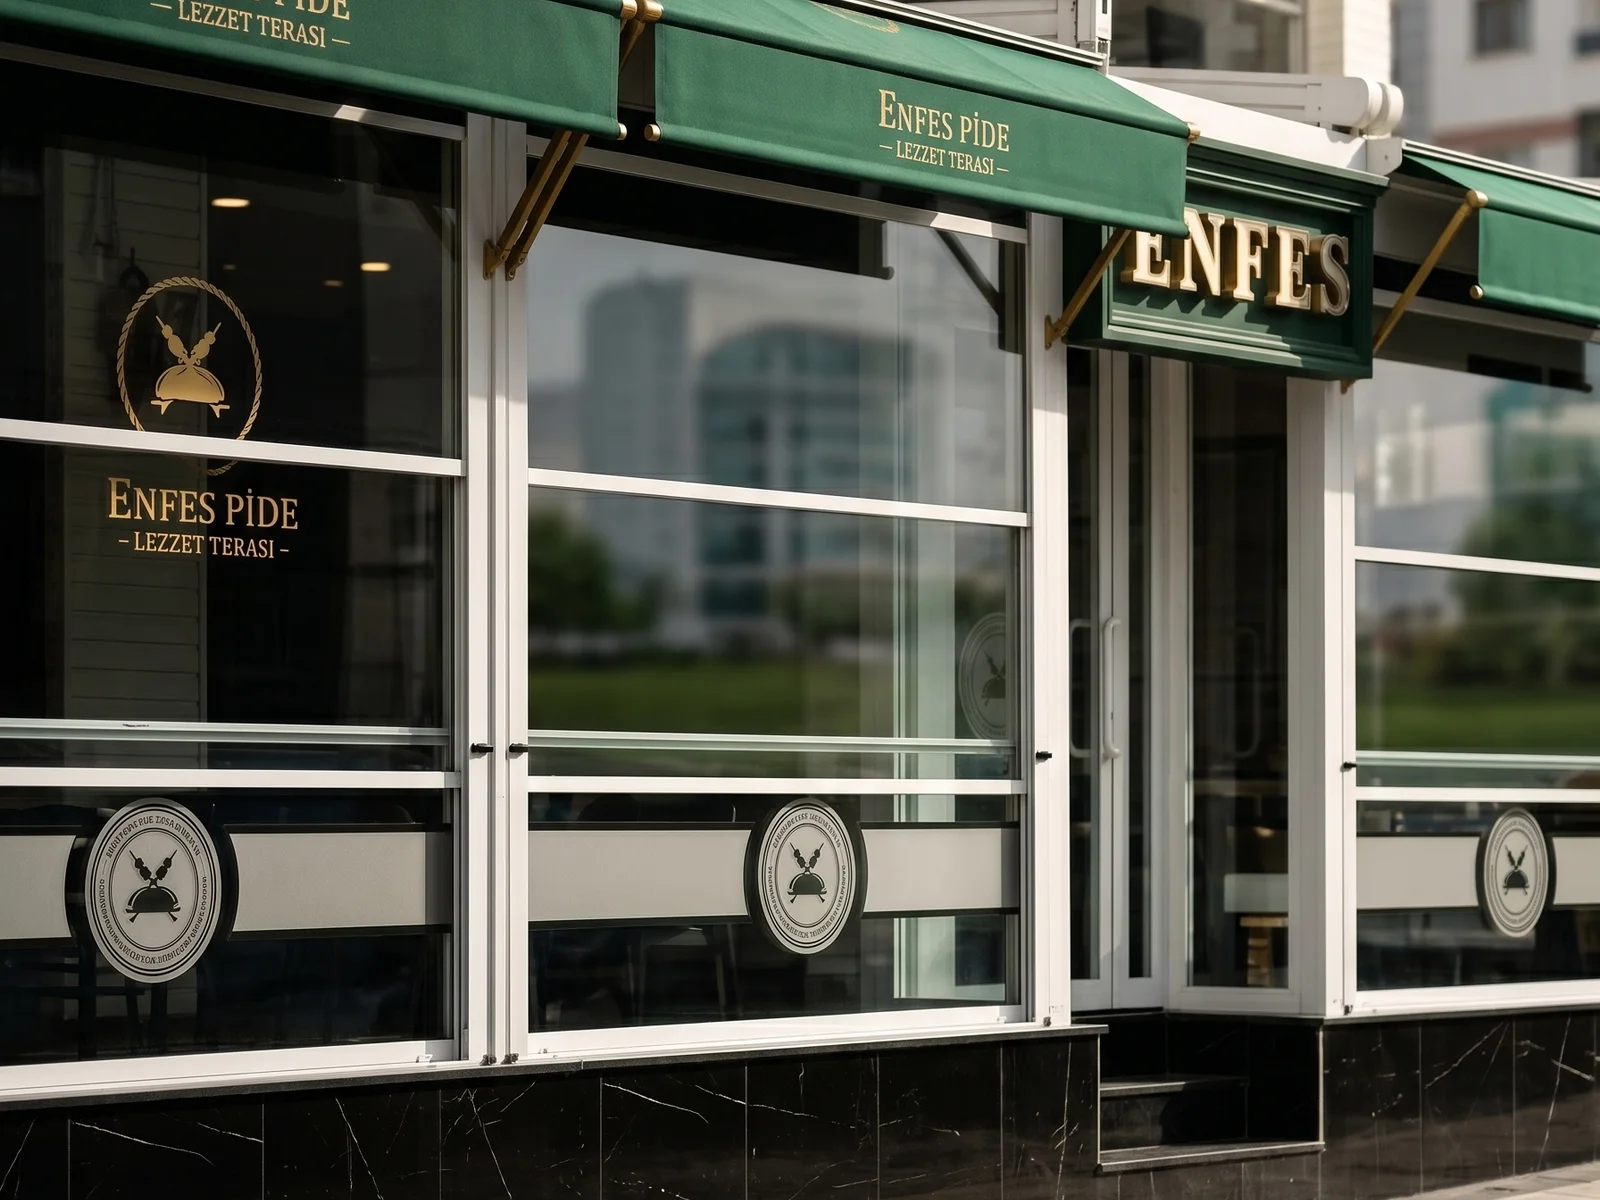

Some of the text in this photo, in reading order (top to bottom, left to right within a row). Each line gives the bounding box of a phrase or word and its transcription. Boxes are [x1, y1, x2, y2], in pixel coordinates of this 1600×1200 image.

[178, 0, 252, 33] LEZZET
[257, 15, 326, 48] TERASI
[878, 89, 1010, 152] ENFES PİDE
[896, 140, 994, 176] LEZZET TERASI
[1131, 207, 1350, 317] ENFES
[108, 477, 299, 530] ENFES PİDE
[133, 531, 275, 559] LEZZET TERASI
